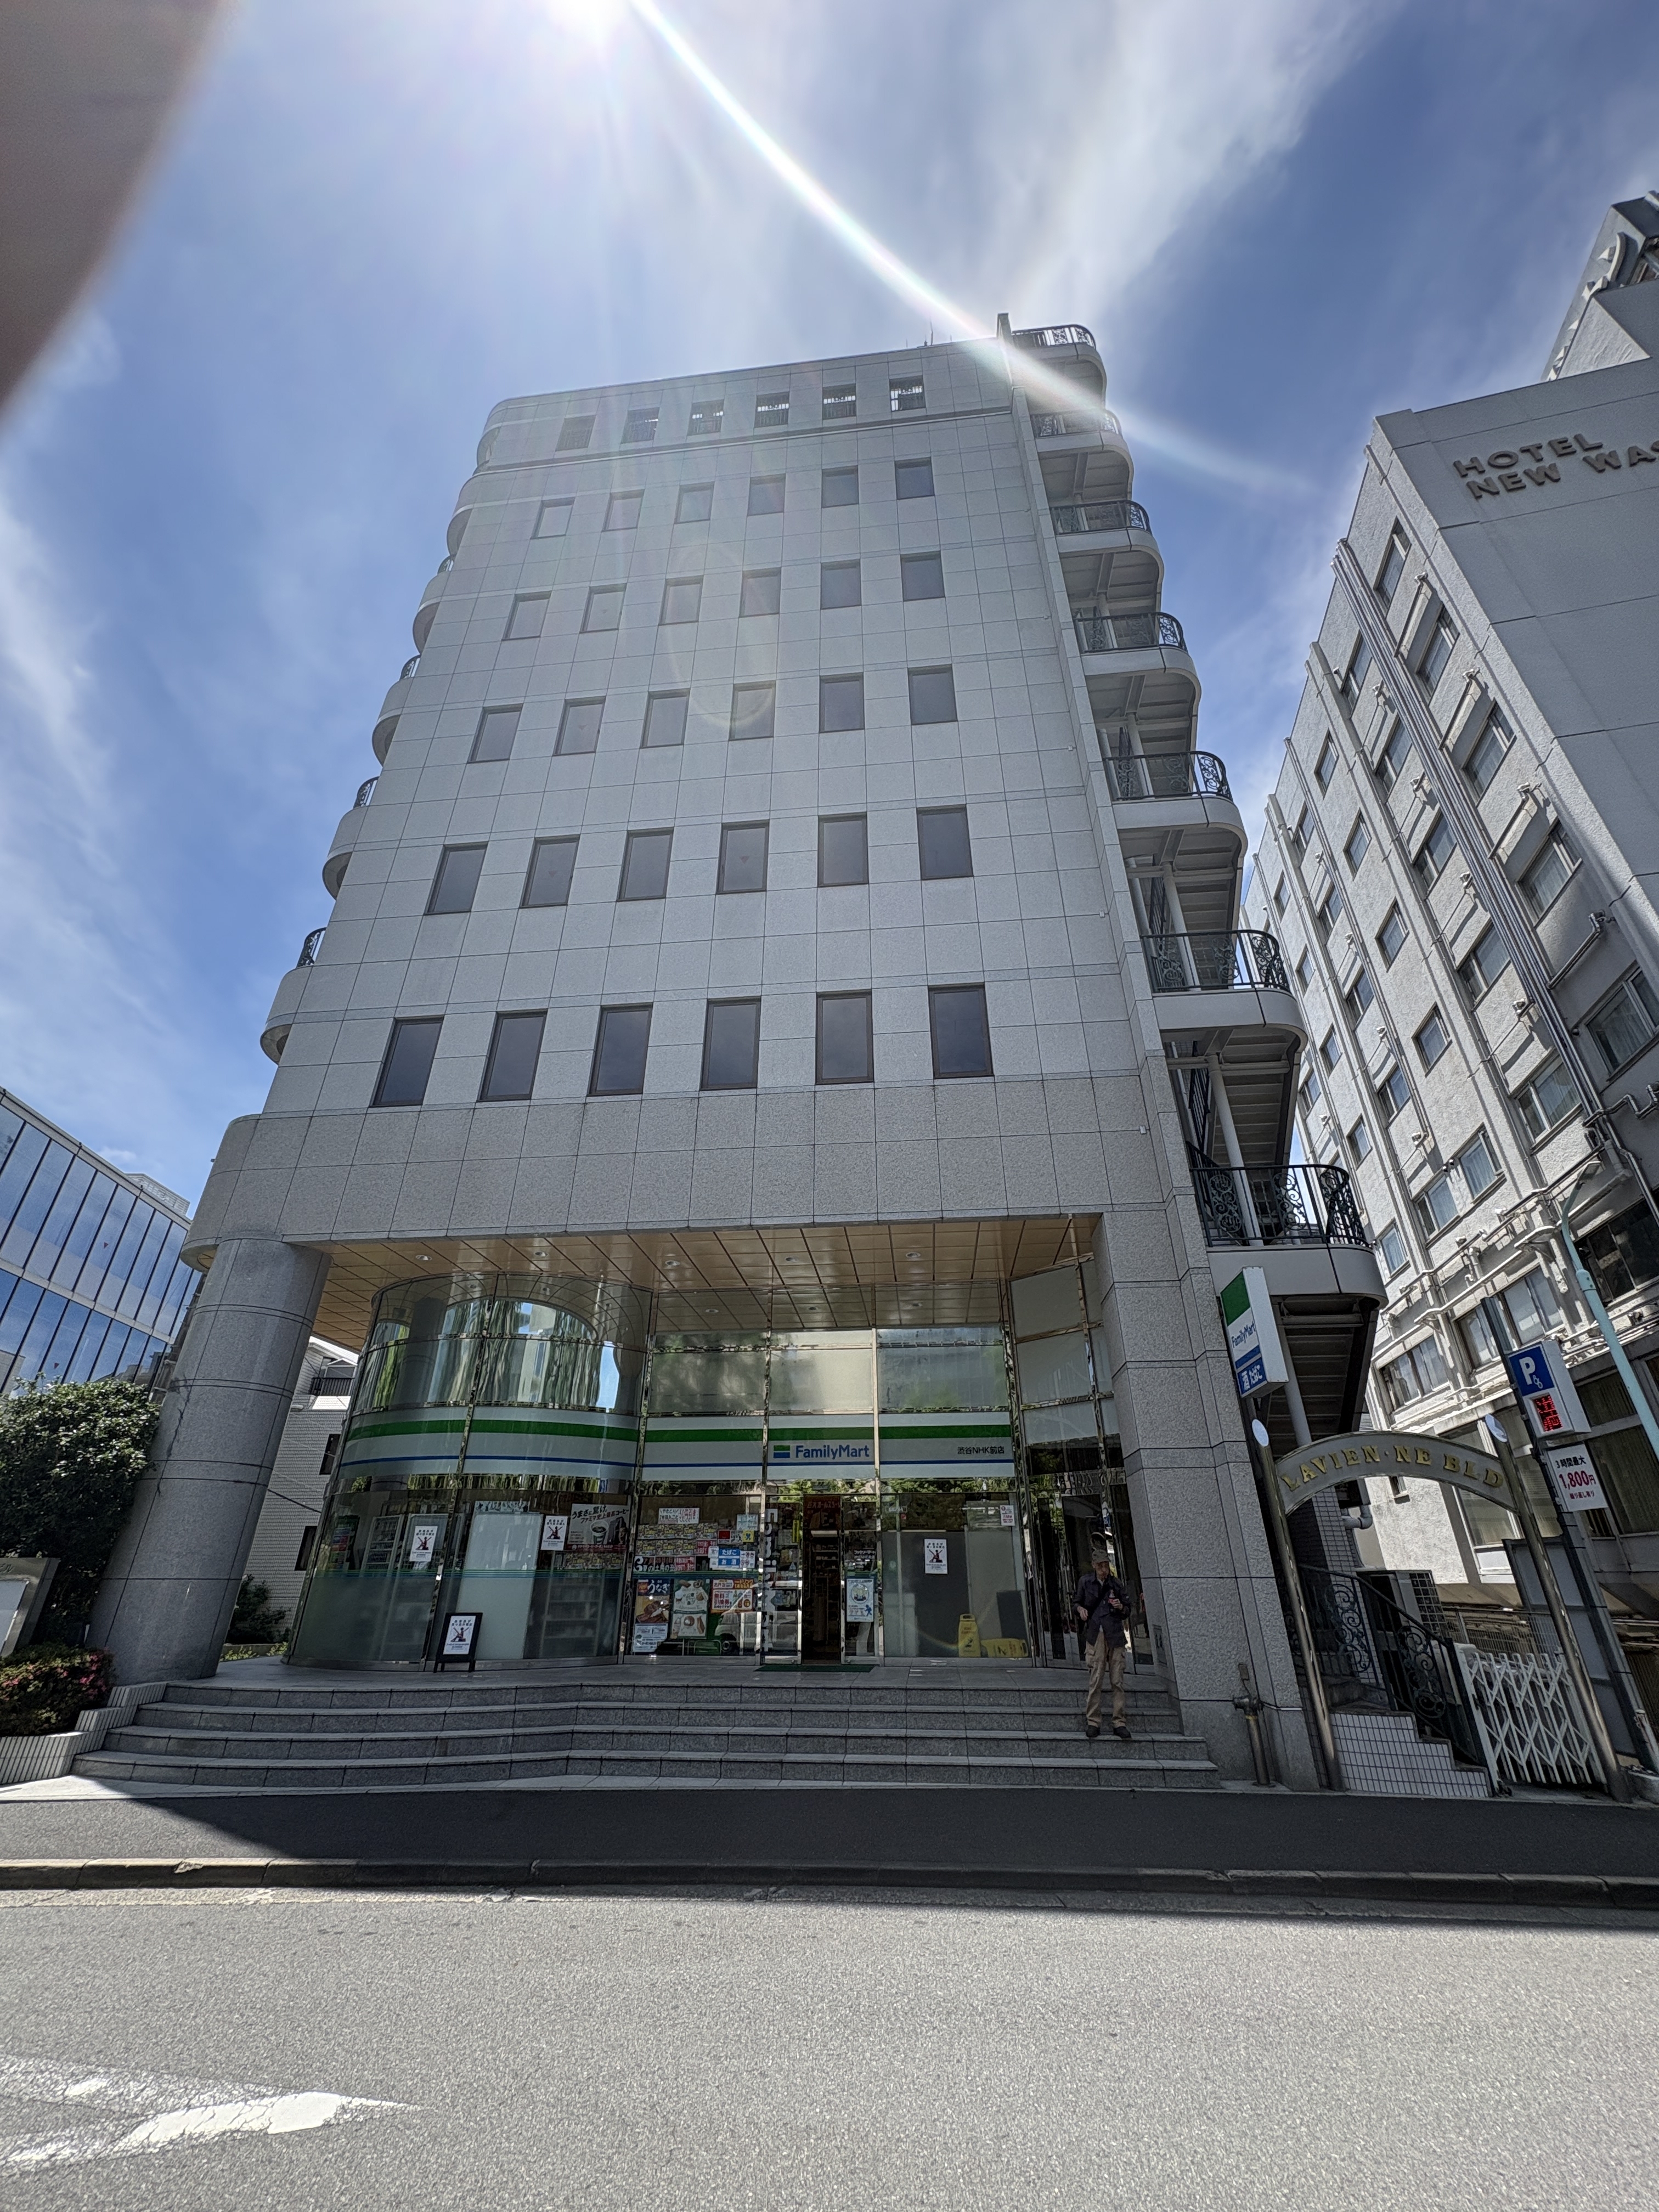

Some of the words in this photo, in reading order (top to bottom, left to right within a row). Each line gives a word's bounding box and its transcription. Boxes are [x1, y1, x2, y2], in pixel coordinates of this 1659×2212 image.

[1453, 433, 1603, 478] HOTEL
[1466, 462, 1561, 499] NEW
[1231, 1321, 1256, 1348] FamilyMart
[1519, 1356, 1536, 1385] P
[795, 1444, 870, 1460] FamilyMart
[957, 1446, 1005, 1454] 渋谷NHK前店
[1555, 1455, 1587, 1468] 3時間最大
[1443, 1453, 1505, 1488] BLD
[1559, 1470, 1596, 1490] 1,800円
[647, 1579, 670, 1594] うなぎ
